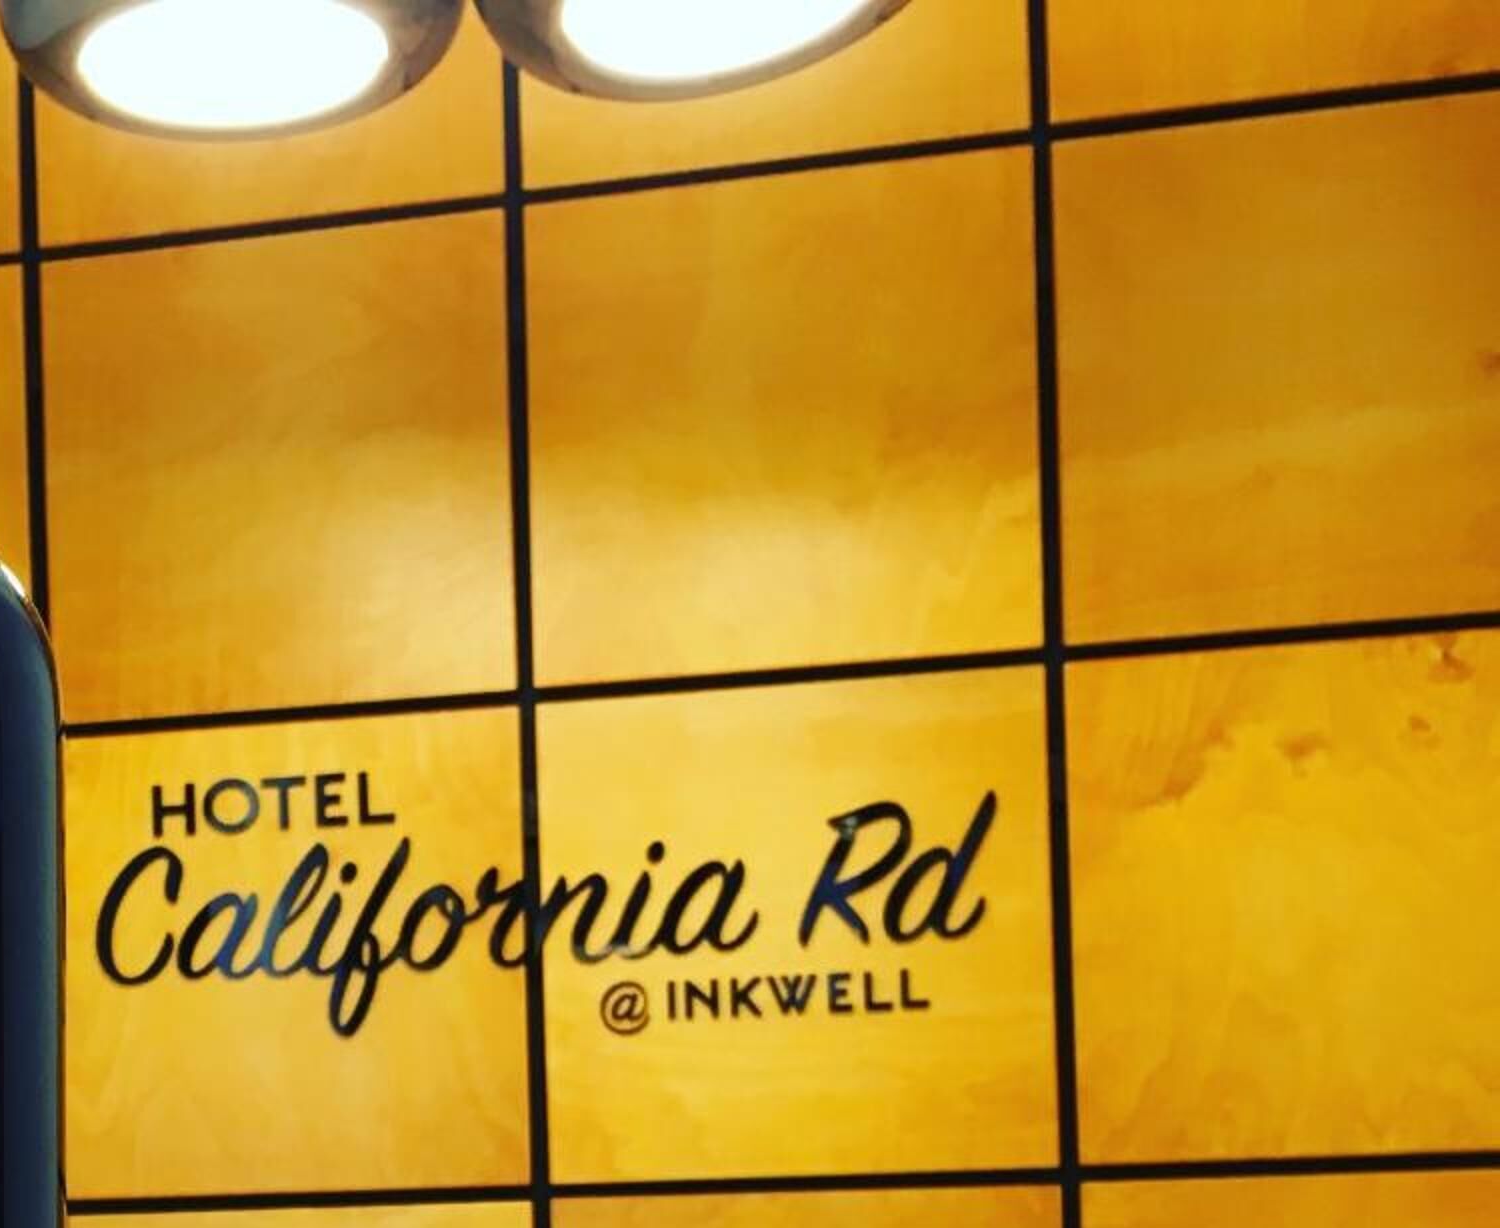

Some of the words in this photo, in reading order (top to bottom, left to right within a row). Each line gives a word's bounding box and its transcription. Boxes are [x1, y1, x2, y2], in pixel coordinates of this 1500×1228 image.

[151, 771, 396, 837] HOTEL
[94, 836, 761, 1037] California
[798, 790, 998, 949] Rd
[599, 980, 651, 1035] @
[667, 970, 930, 1022] INKWELL
